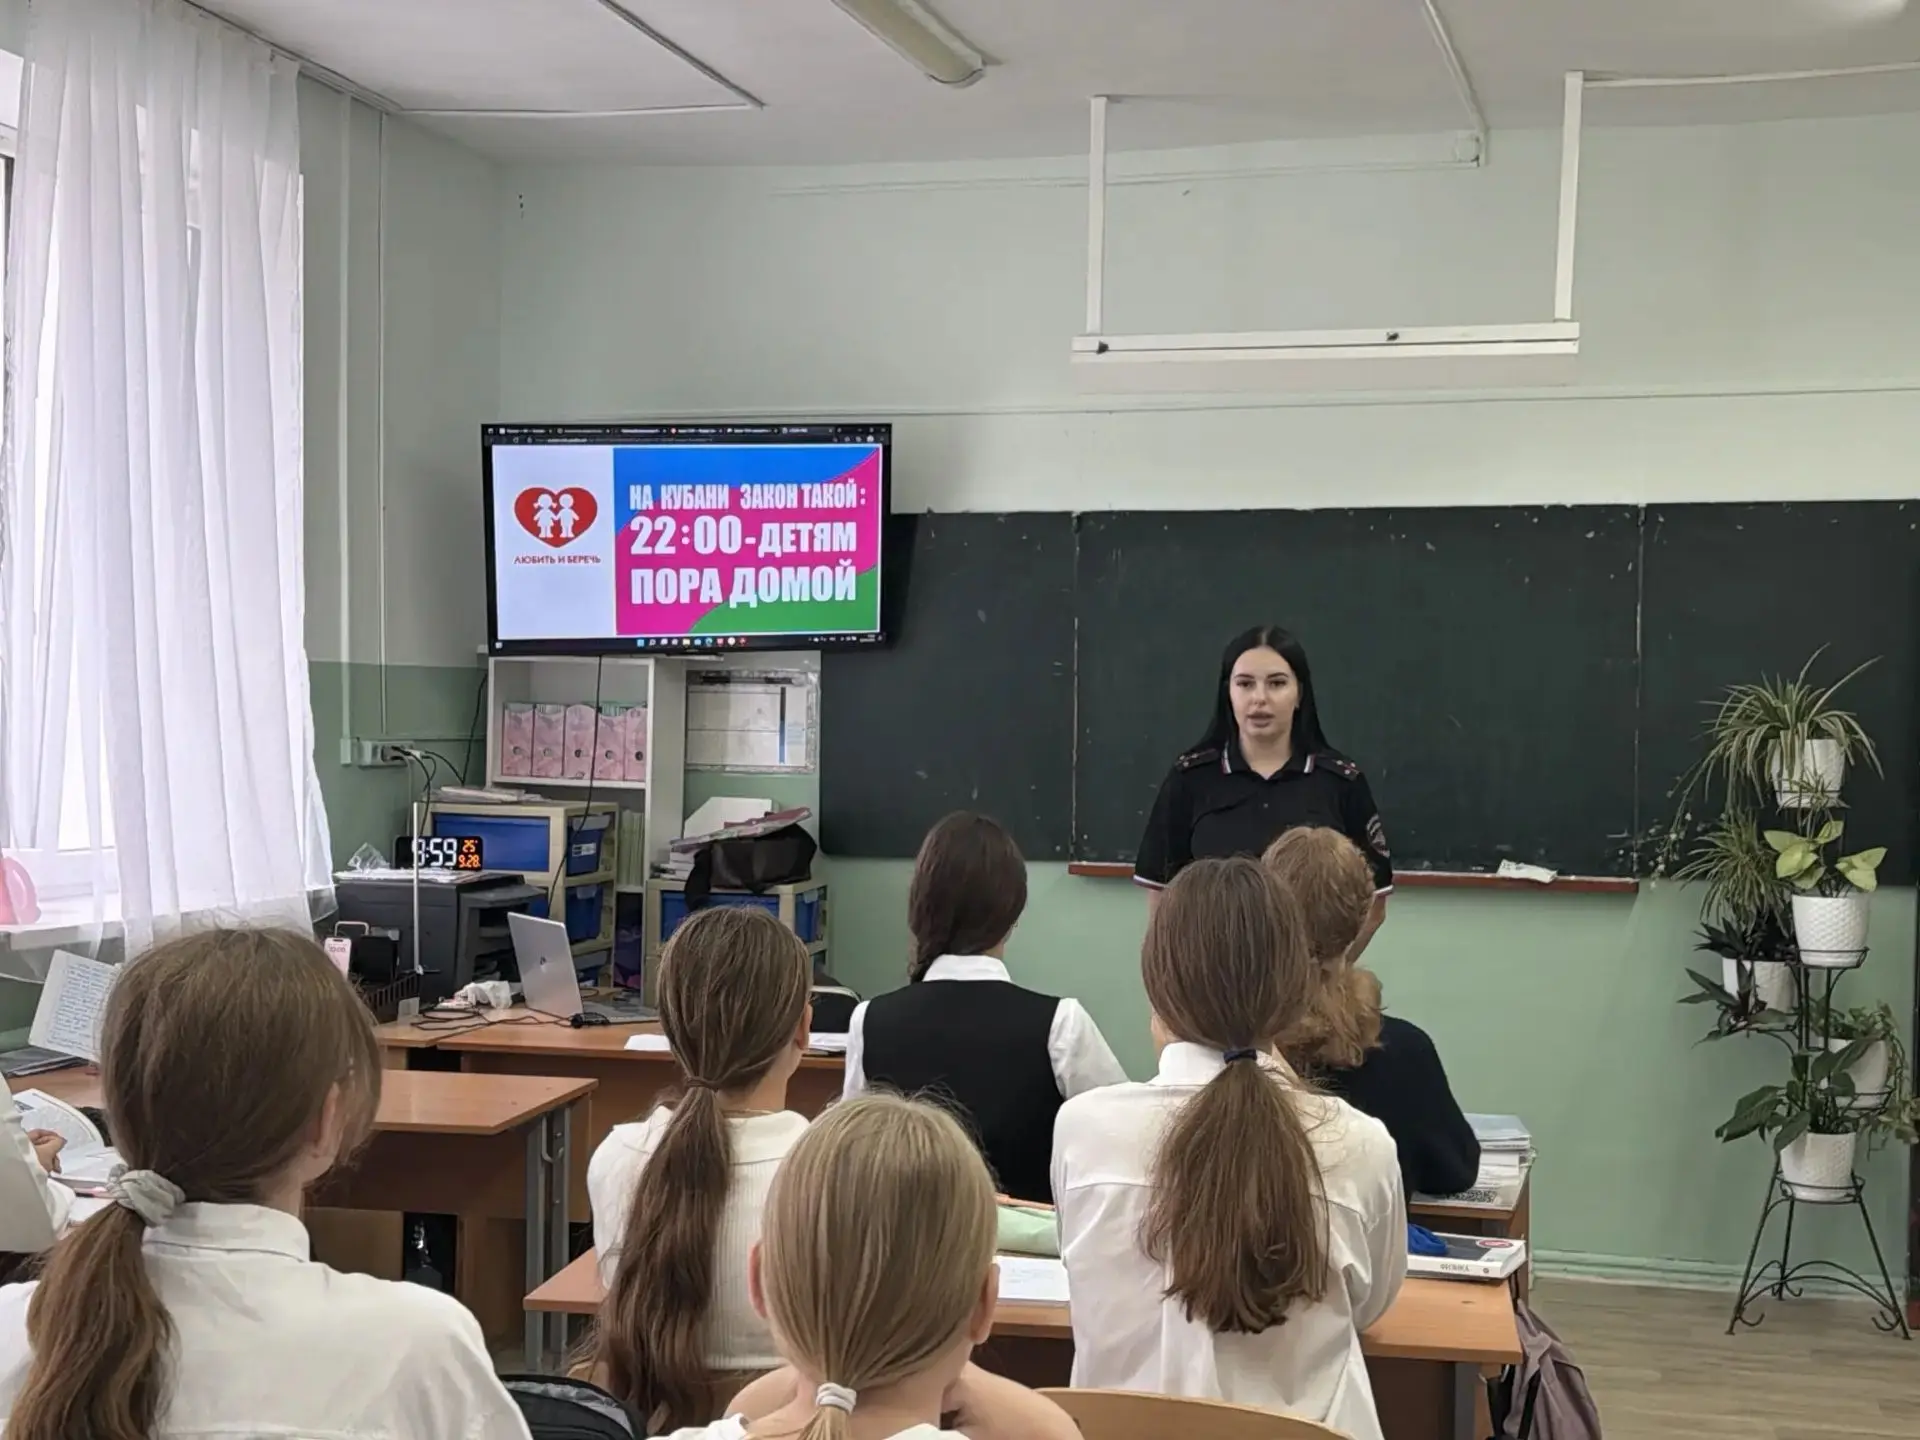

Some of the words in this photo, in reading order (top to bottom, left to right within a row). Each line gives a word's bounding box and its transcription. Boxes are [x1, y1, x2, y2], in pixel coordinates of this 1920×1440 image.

[629, 484, 654, 510] НА
[660, 484, 729, 510] КУБАНИ
[740, 483, 798, 509] ЗАКОН
[514, 555, 555, 564] ЛЮБИТЬ
[558, 555, 565, 564] И
[567, 555, 601, 564] БЕРЕЧЬ
[631, 567, 723, 604] ПОРА
[729, 558, 857, 608] ДОМОЙ
